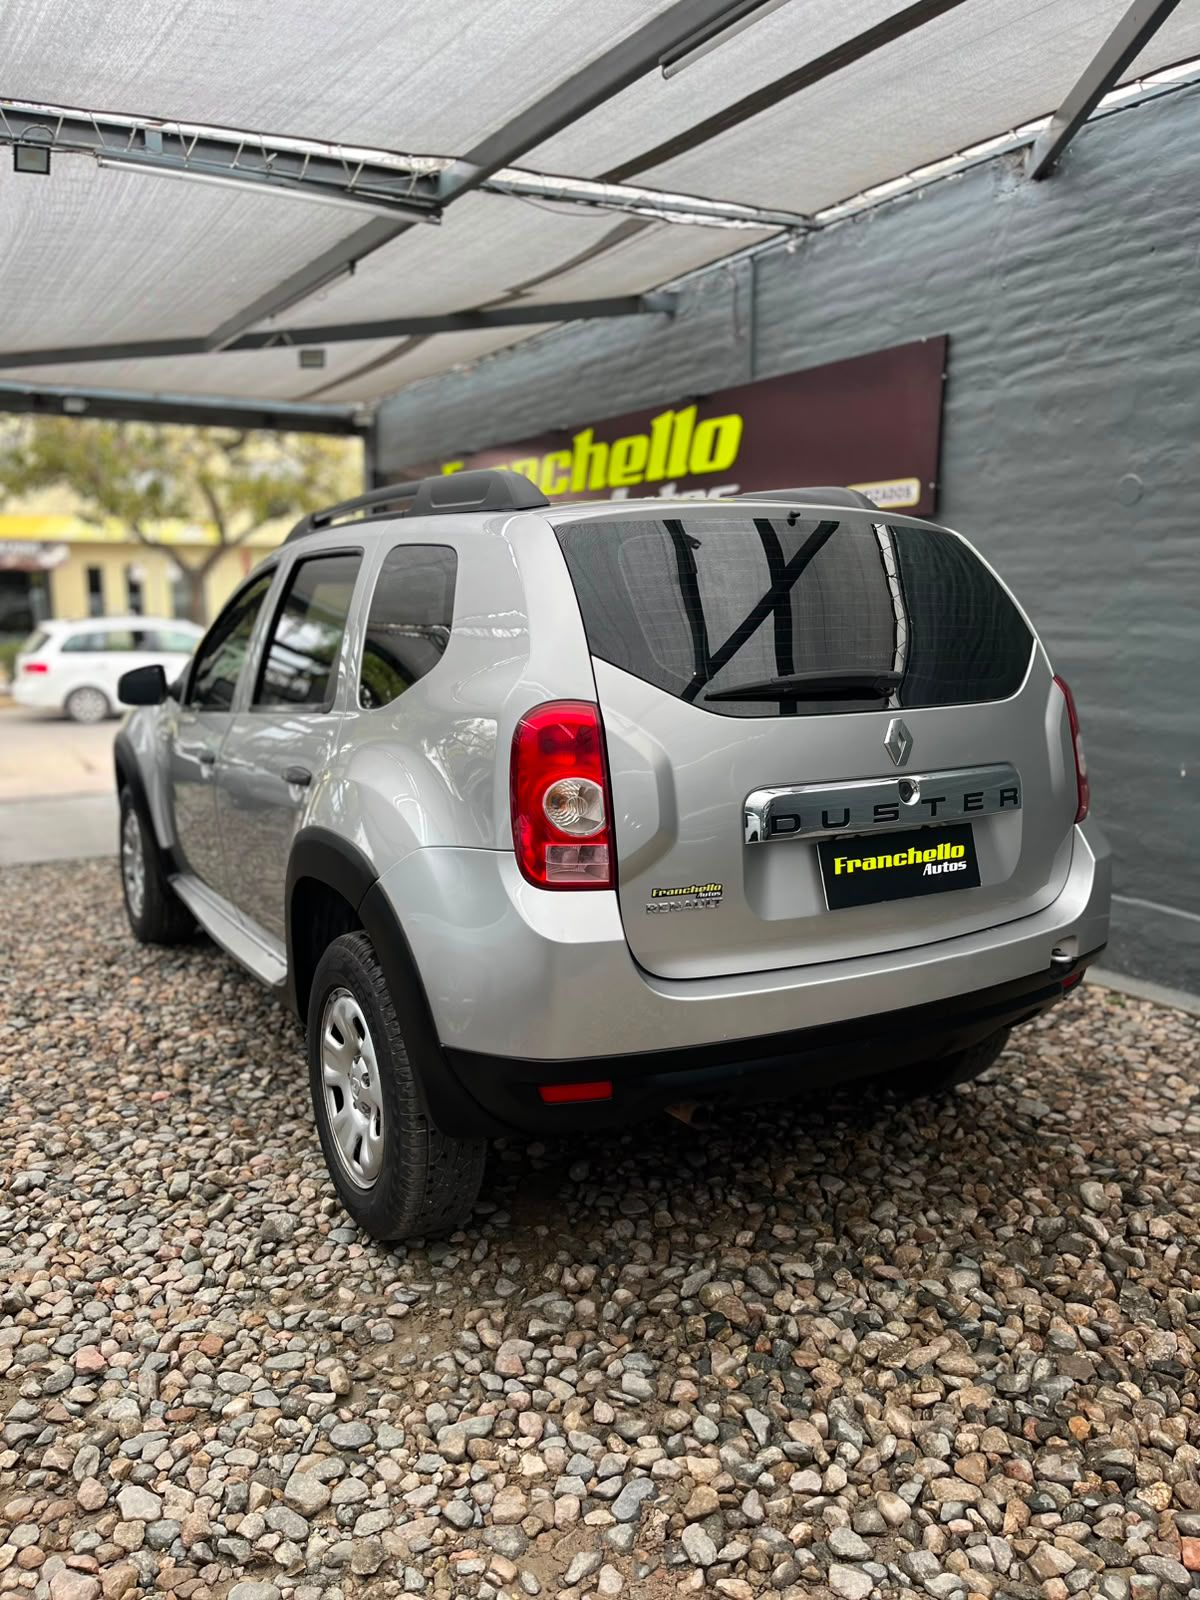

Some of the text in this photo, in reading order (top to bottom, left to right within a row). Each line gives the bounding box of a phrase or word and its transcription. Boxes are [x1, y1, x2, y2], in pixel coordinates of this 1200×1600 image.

[770, 786, 1021, 834] DUSTER
[833, 842, 966, 875] Franchello
[922, 860, 967, 876] Autos
[651, 883, 723, 898] Franchello
[645, 897, 723, 914] RENAULT
